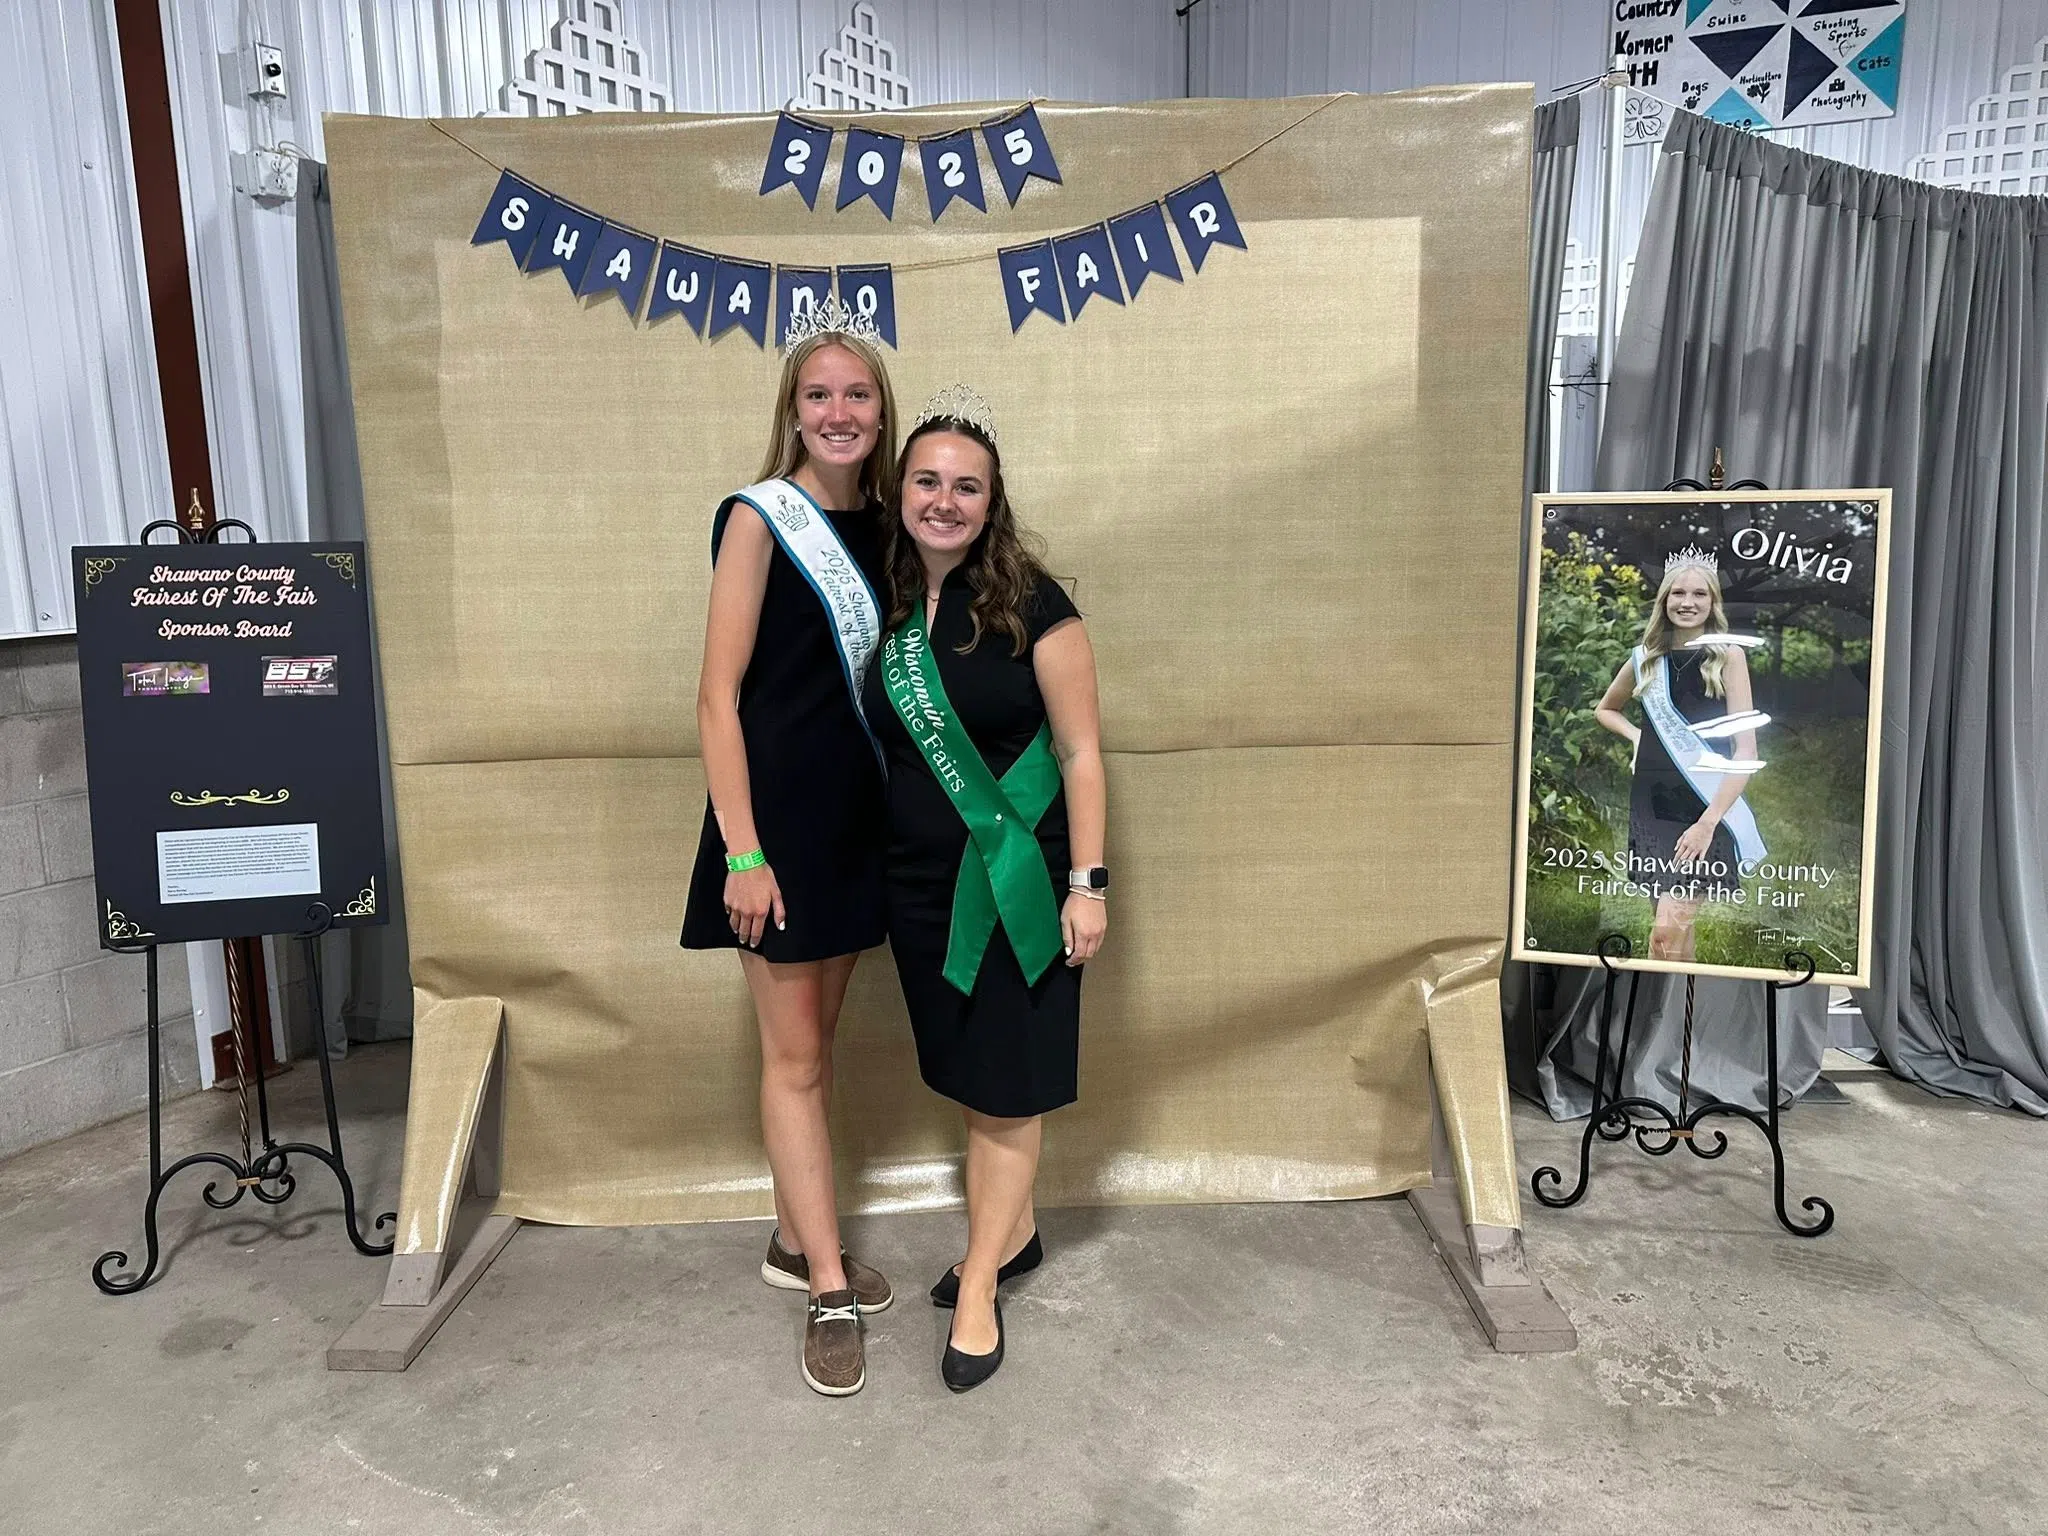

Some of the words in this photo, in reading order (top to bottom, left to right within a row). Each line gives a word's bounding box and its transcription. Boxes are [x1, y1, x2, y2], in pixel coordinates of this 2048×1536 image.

[1616, 0, 1682, 21] Country
[1707, 14, 1747, 28] Swine
[1813, 17, 1859, 31] Shooting
[1828, 28, 1867, 42] Sports
[1615, 30, 1674, 56] Korner
[1858, 56, 1891, 71] Cats
[1681, 81, 1709, 96] Dogs
[1811, 90, 1867, 110] Photography
[784, 128, 1033, 187] 2025
[1017, 202, 1220, 304] FAIR
[1731, 527, 1853, 584] Olivia
[150, 565, 234, 584] Shawano
[236, 565, 296, 585] County
[130, 587, 198, 607] Fairest
[202, 587, 229, 608] Of
[232, 584, 270, 605] The
[273, 586, 318, 607] Fair
[820, 549, 857, 585] 2025
[849, 591, 871, 651] Shawano
[818, 568, 851, 617] Fairest
[841, 622, 859, 636] of
[850, 641, 867, 663] the
[158, 619, 231, 640] Sponsor
[234, 620, 293, 638] Board
[888, 667, 910, 692] of
[901, 628, 945, 731] Wisconsin
[898, 693, 925, 732] the
[921, 731, 965, 793] Fairs
[1543, 847, 1604, 870] 2025
[1612, 849, 1728, 877] Shawano
[1737, 857, 1836, 889] County
[1578, 875, 1661, 899] Fairest
[1669, 879, 1701, 901] of
[1706, 880, 1747, 904] the
[1757, 886, 1806, 908] Fair
